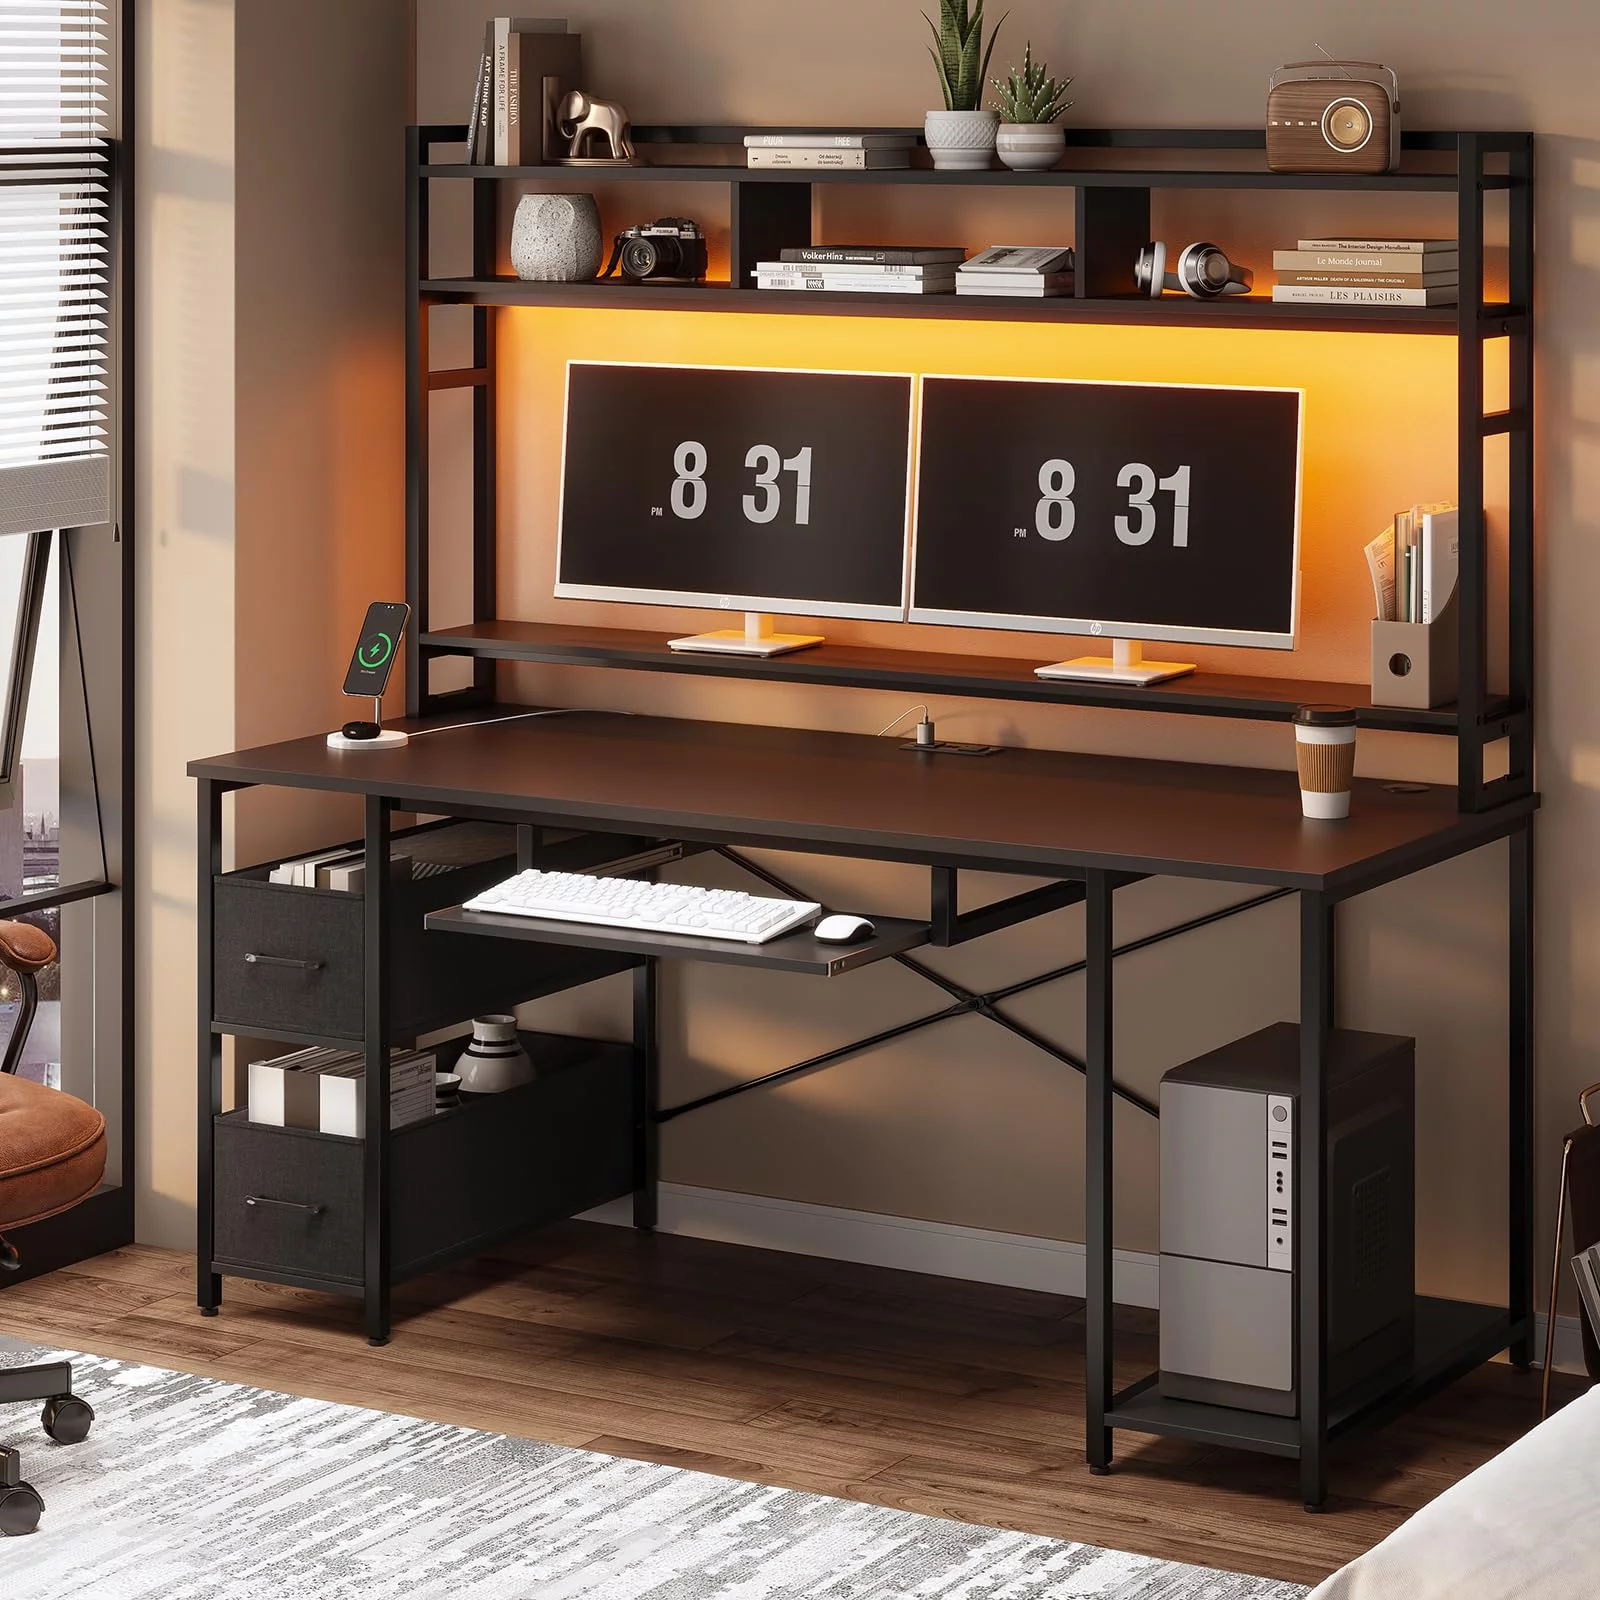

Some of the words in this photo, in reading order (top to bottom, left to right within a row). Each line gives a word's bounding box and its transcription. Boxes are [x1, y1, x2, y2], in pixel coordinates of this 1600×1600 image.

[498, 51, 506, 78] FRAME
[498, 80, 506, 95] FOR
[510, 68, 518, 87] THE
[482, 75, 491, 105] DRINK
[498, 95, 506, 112] LIFE
[509, 88, 518, 126] FASHION
[480, 106, 488, 127] NAP
[763, 136, 784, 145] PUUR
[1317, 257, 1326, 265] Le
[1327, 257, 1353, 266] Monde
[1354, 258, 1383, 266] Journal
[1330, 291, 1349, 300] LES
[1353, 291, 1403, 301] PLAISIRS
[650, 506, 664, 517] PM
[669, 440, 708, 521] 8
[742, 443, 813, 526] 31
[1013, 527, 1027, 539] PM
[1034, 458, 1076, 542] 8
[1113, 462, 1191, 548] 31
